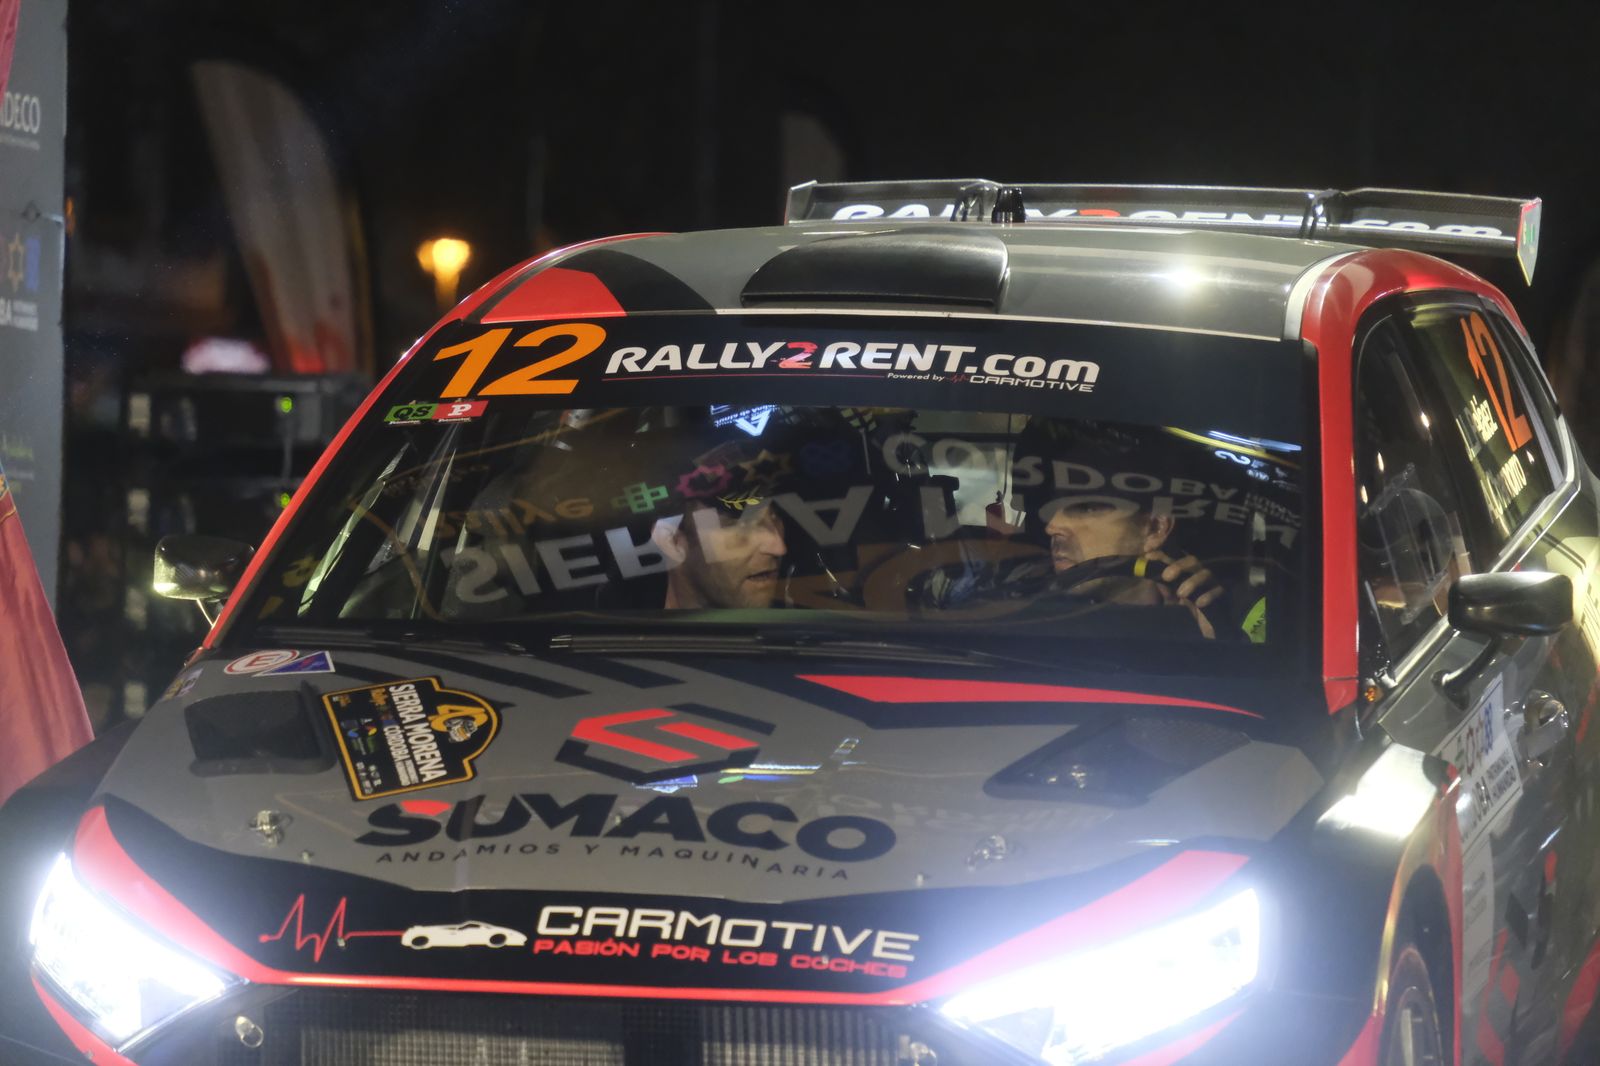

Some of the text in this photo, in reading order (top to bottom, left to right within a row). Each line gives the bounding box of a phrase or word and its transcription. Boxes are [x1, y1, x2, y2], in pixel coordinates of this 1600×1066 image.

[0, 91, 41, 134] DECO
[432, 322, 606, 398] 12
[887, 372, 1096, 393] Powered by CARMOTIVE
[1460, 311, 1533, 452] 12
[388, 683, 427, 724] SIERRA
[404, 721, 448, 783] MORENA
[353, 793, 897, 863] SUMACO
[376, 843, 849, 880] ANDAMIOS Y MAQUINARIA
[533, 937, 908, 979] PASIÓN POR LOS COCHES
[536, 905, 921, 962] CARMOTIVE
